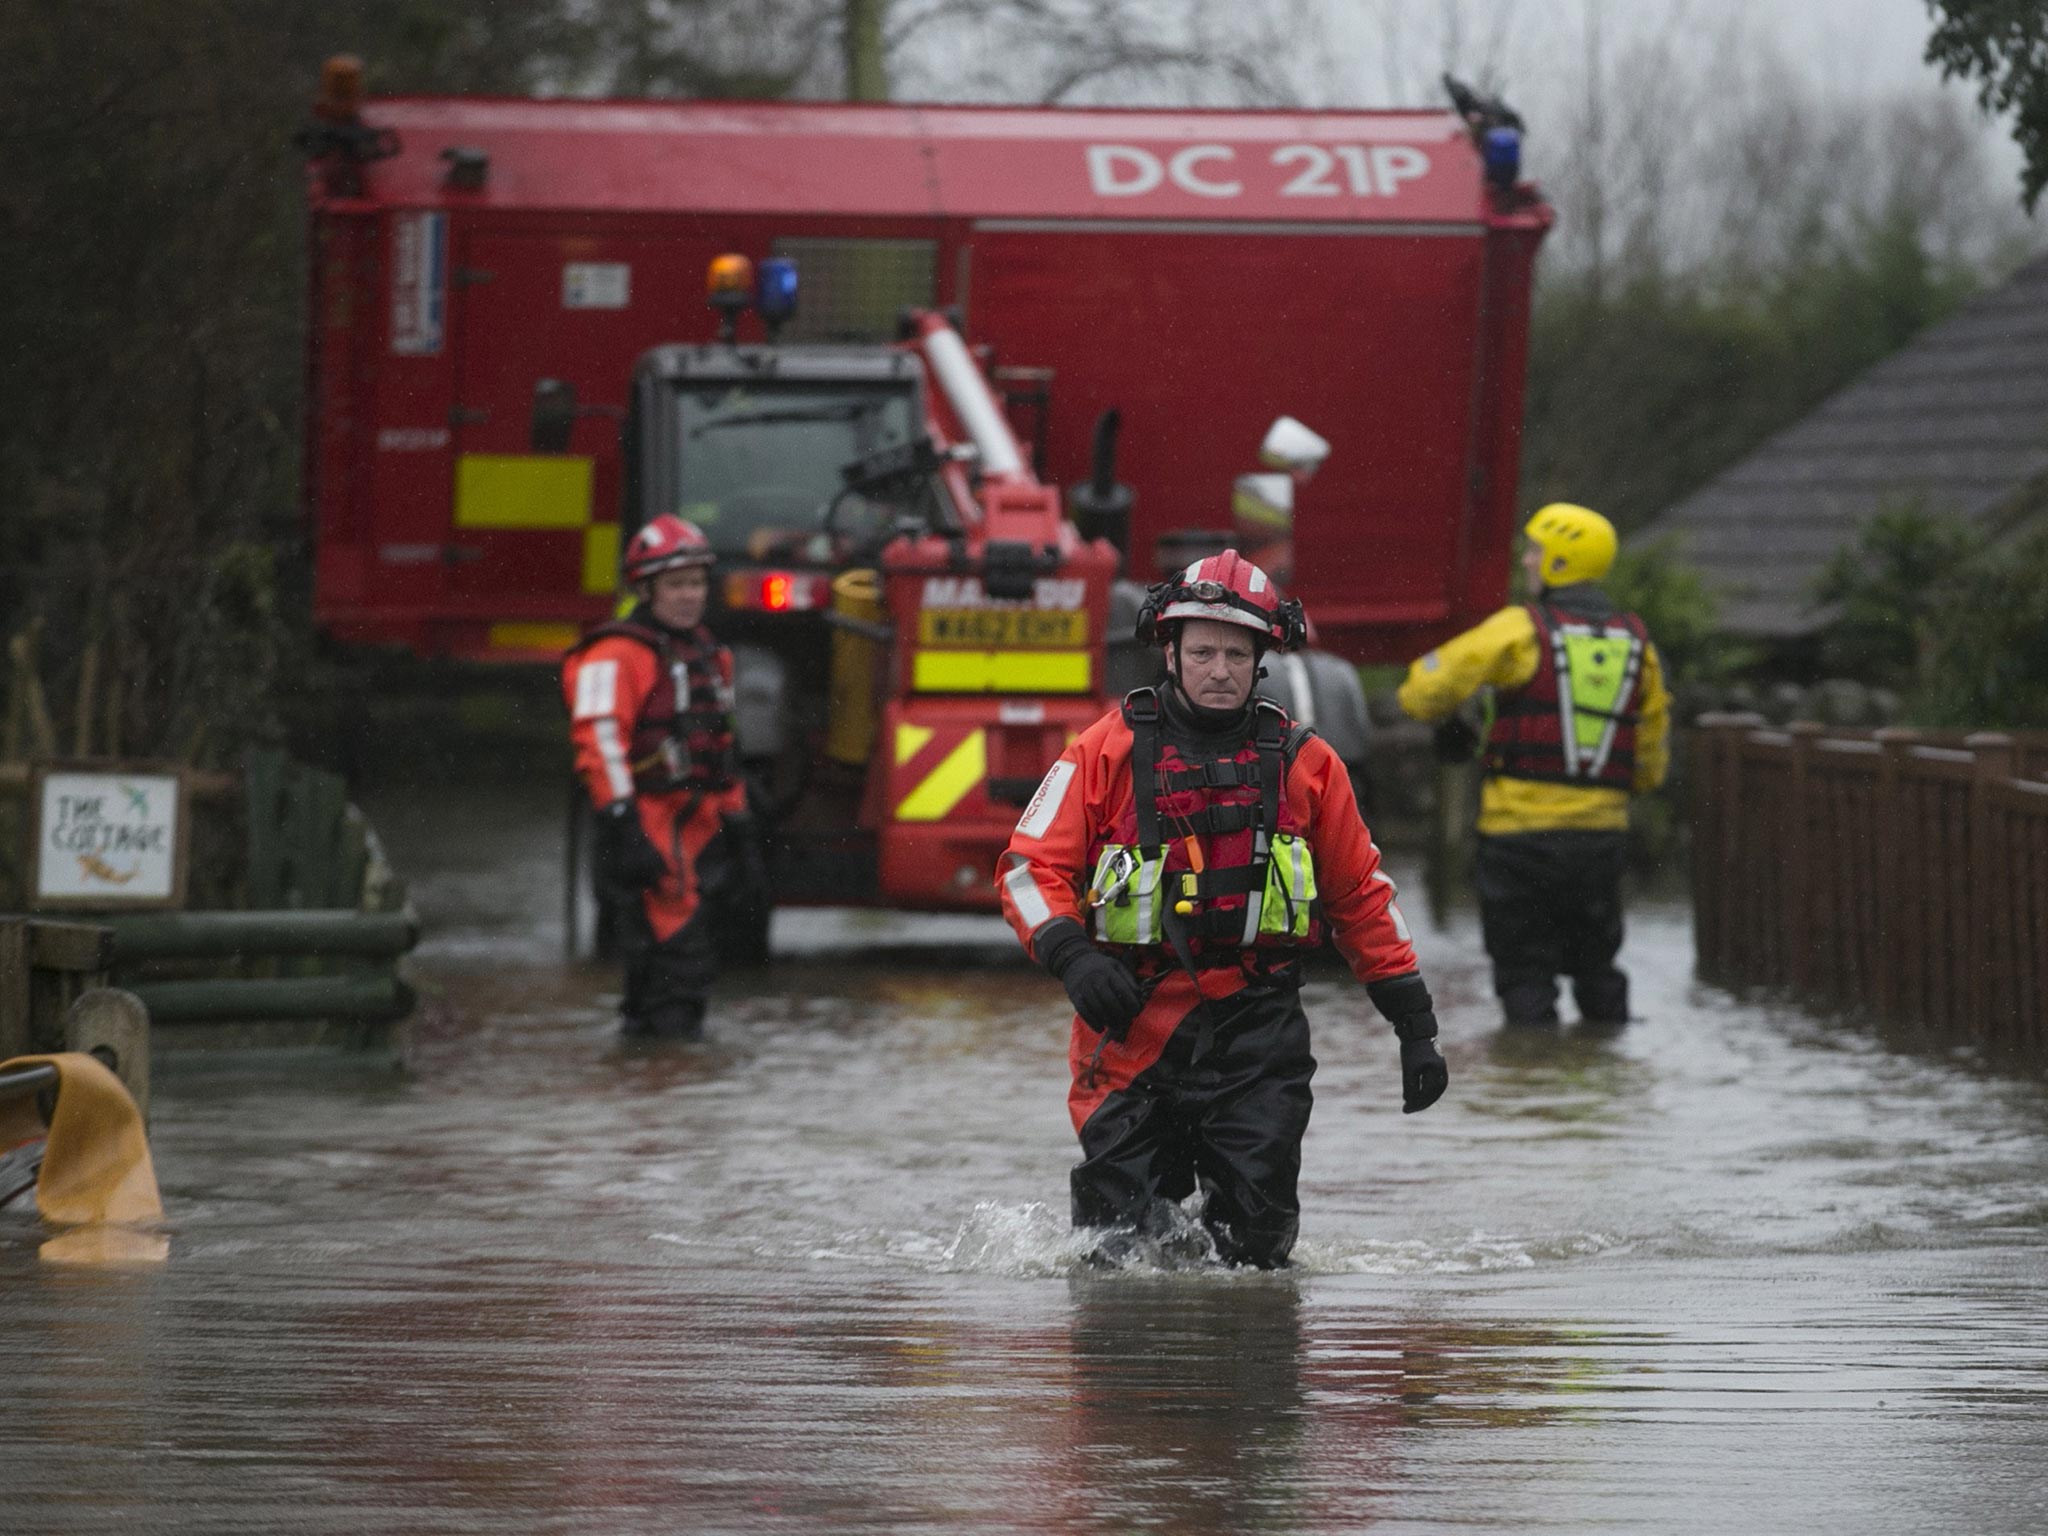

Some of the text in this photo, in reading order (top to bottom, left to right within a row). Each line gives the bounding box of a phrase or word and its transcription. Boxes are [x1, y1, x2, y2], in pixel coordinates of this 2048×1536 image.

[1085, 144, 1430, 198] DC 21P
[1020, 765, 1060, 828] RESCUE
